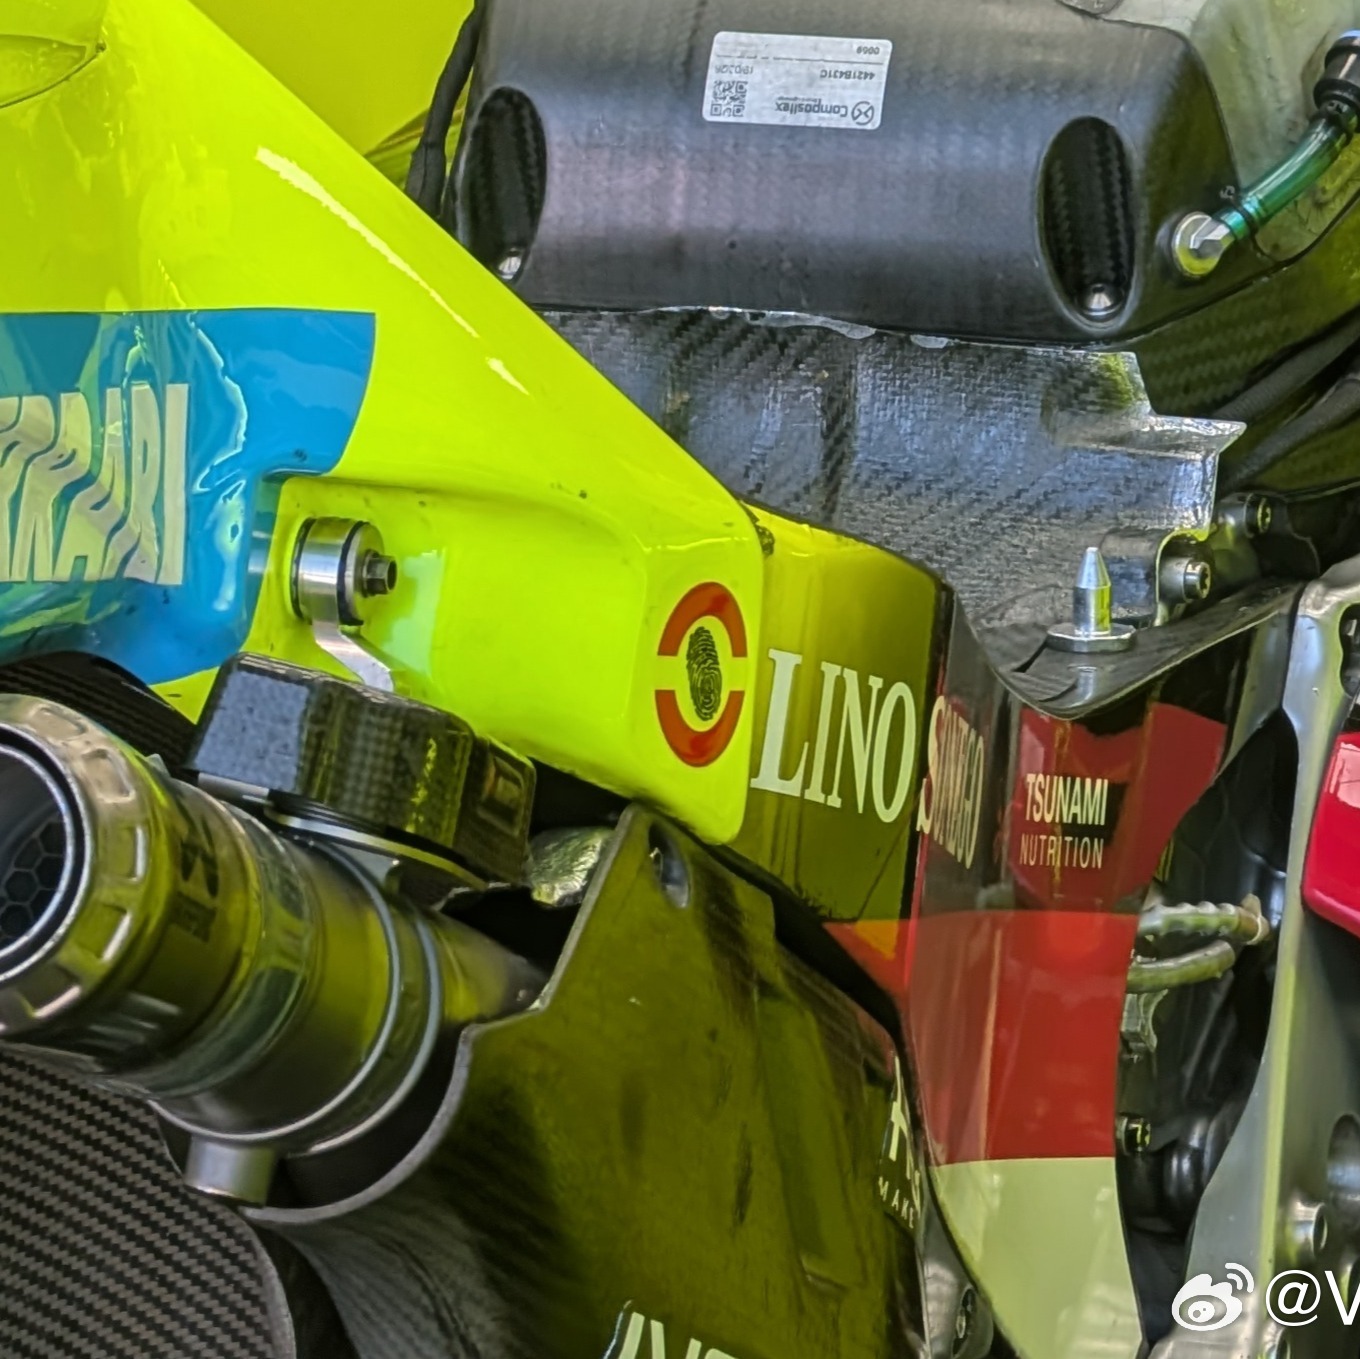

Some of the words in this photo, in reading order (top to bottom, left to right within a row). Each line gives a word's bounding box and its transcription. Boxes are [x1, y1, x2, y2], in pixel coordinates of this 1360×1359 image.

[750, 648, 916, 823] LINO
[1026, 773, 1108, 826] TSUNAMI
[1020, 833, 1104, 869] NUTRITION
